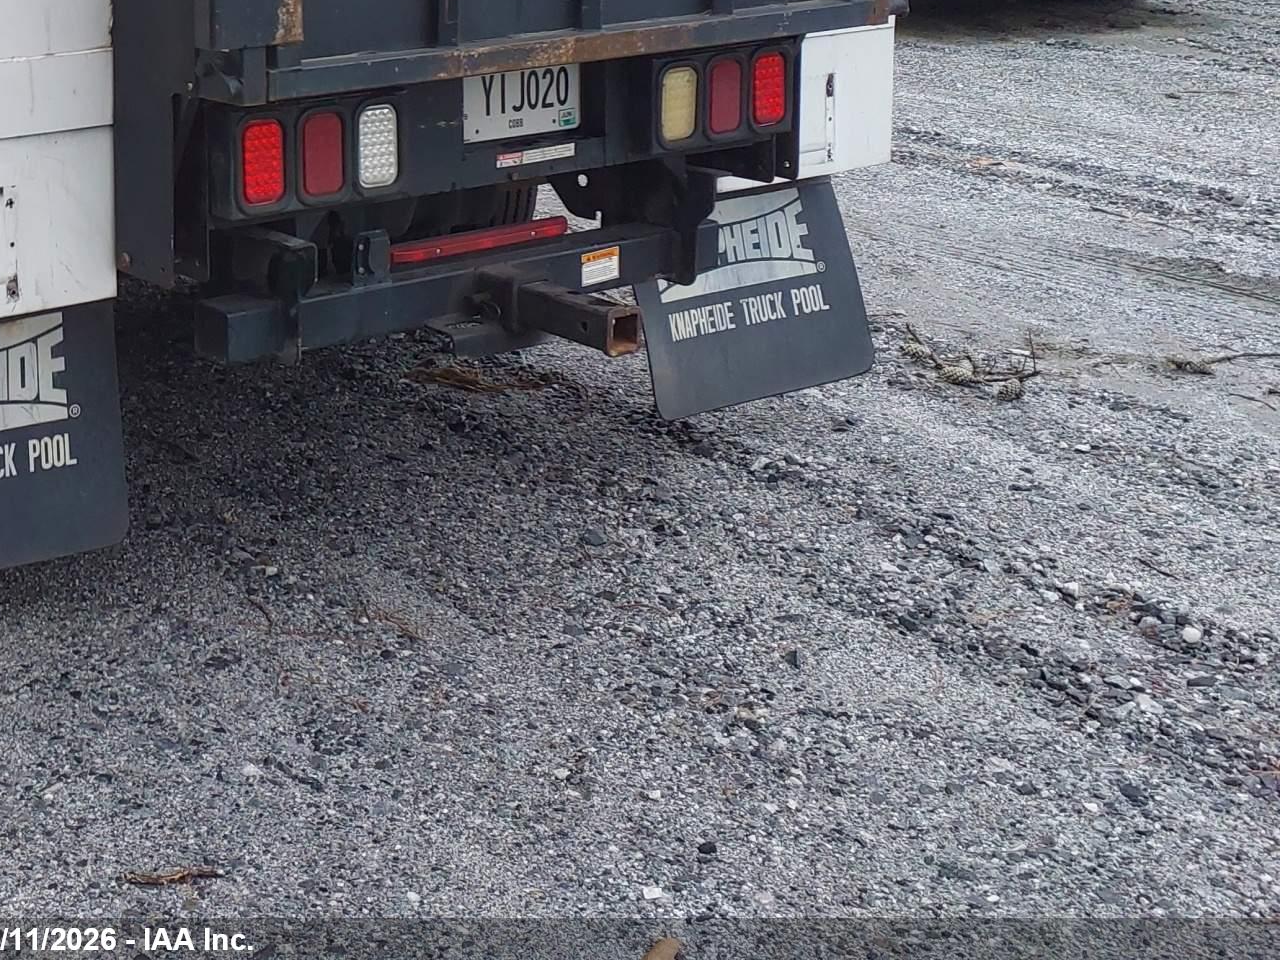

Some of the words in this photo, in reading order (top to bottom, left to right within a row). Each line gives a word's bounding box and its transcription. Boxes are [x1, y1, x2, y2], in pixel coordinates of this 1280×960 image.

[669, 302, 736, 342] KNAPHEIDE
[740, 292, 787, 325] TRUCK
[792, 285, 830, 316] POOL
[28, 433, 78, 473] POOL
